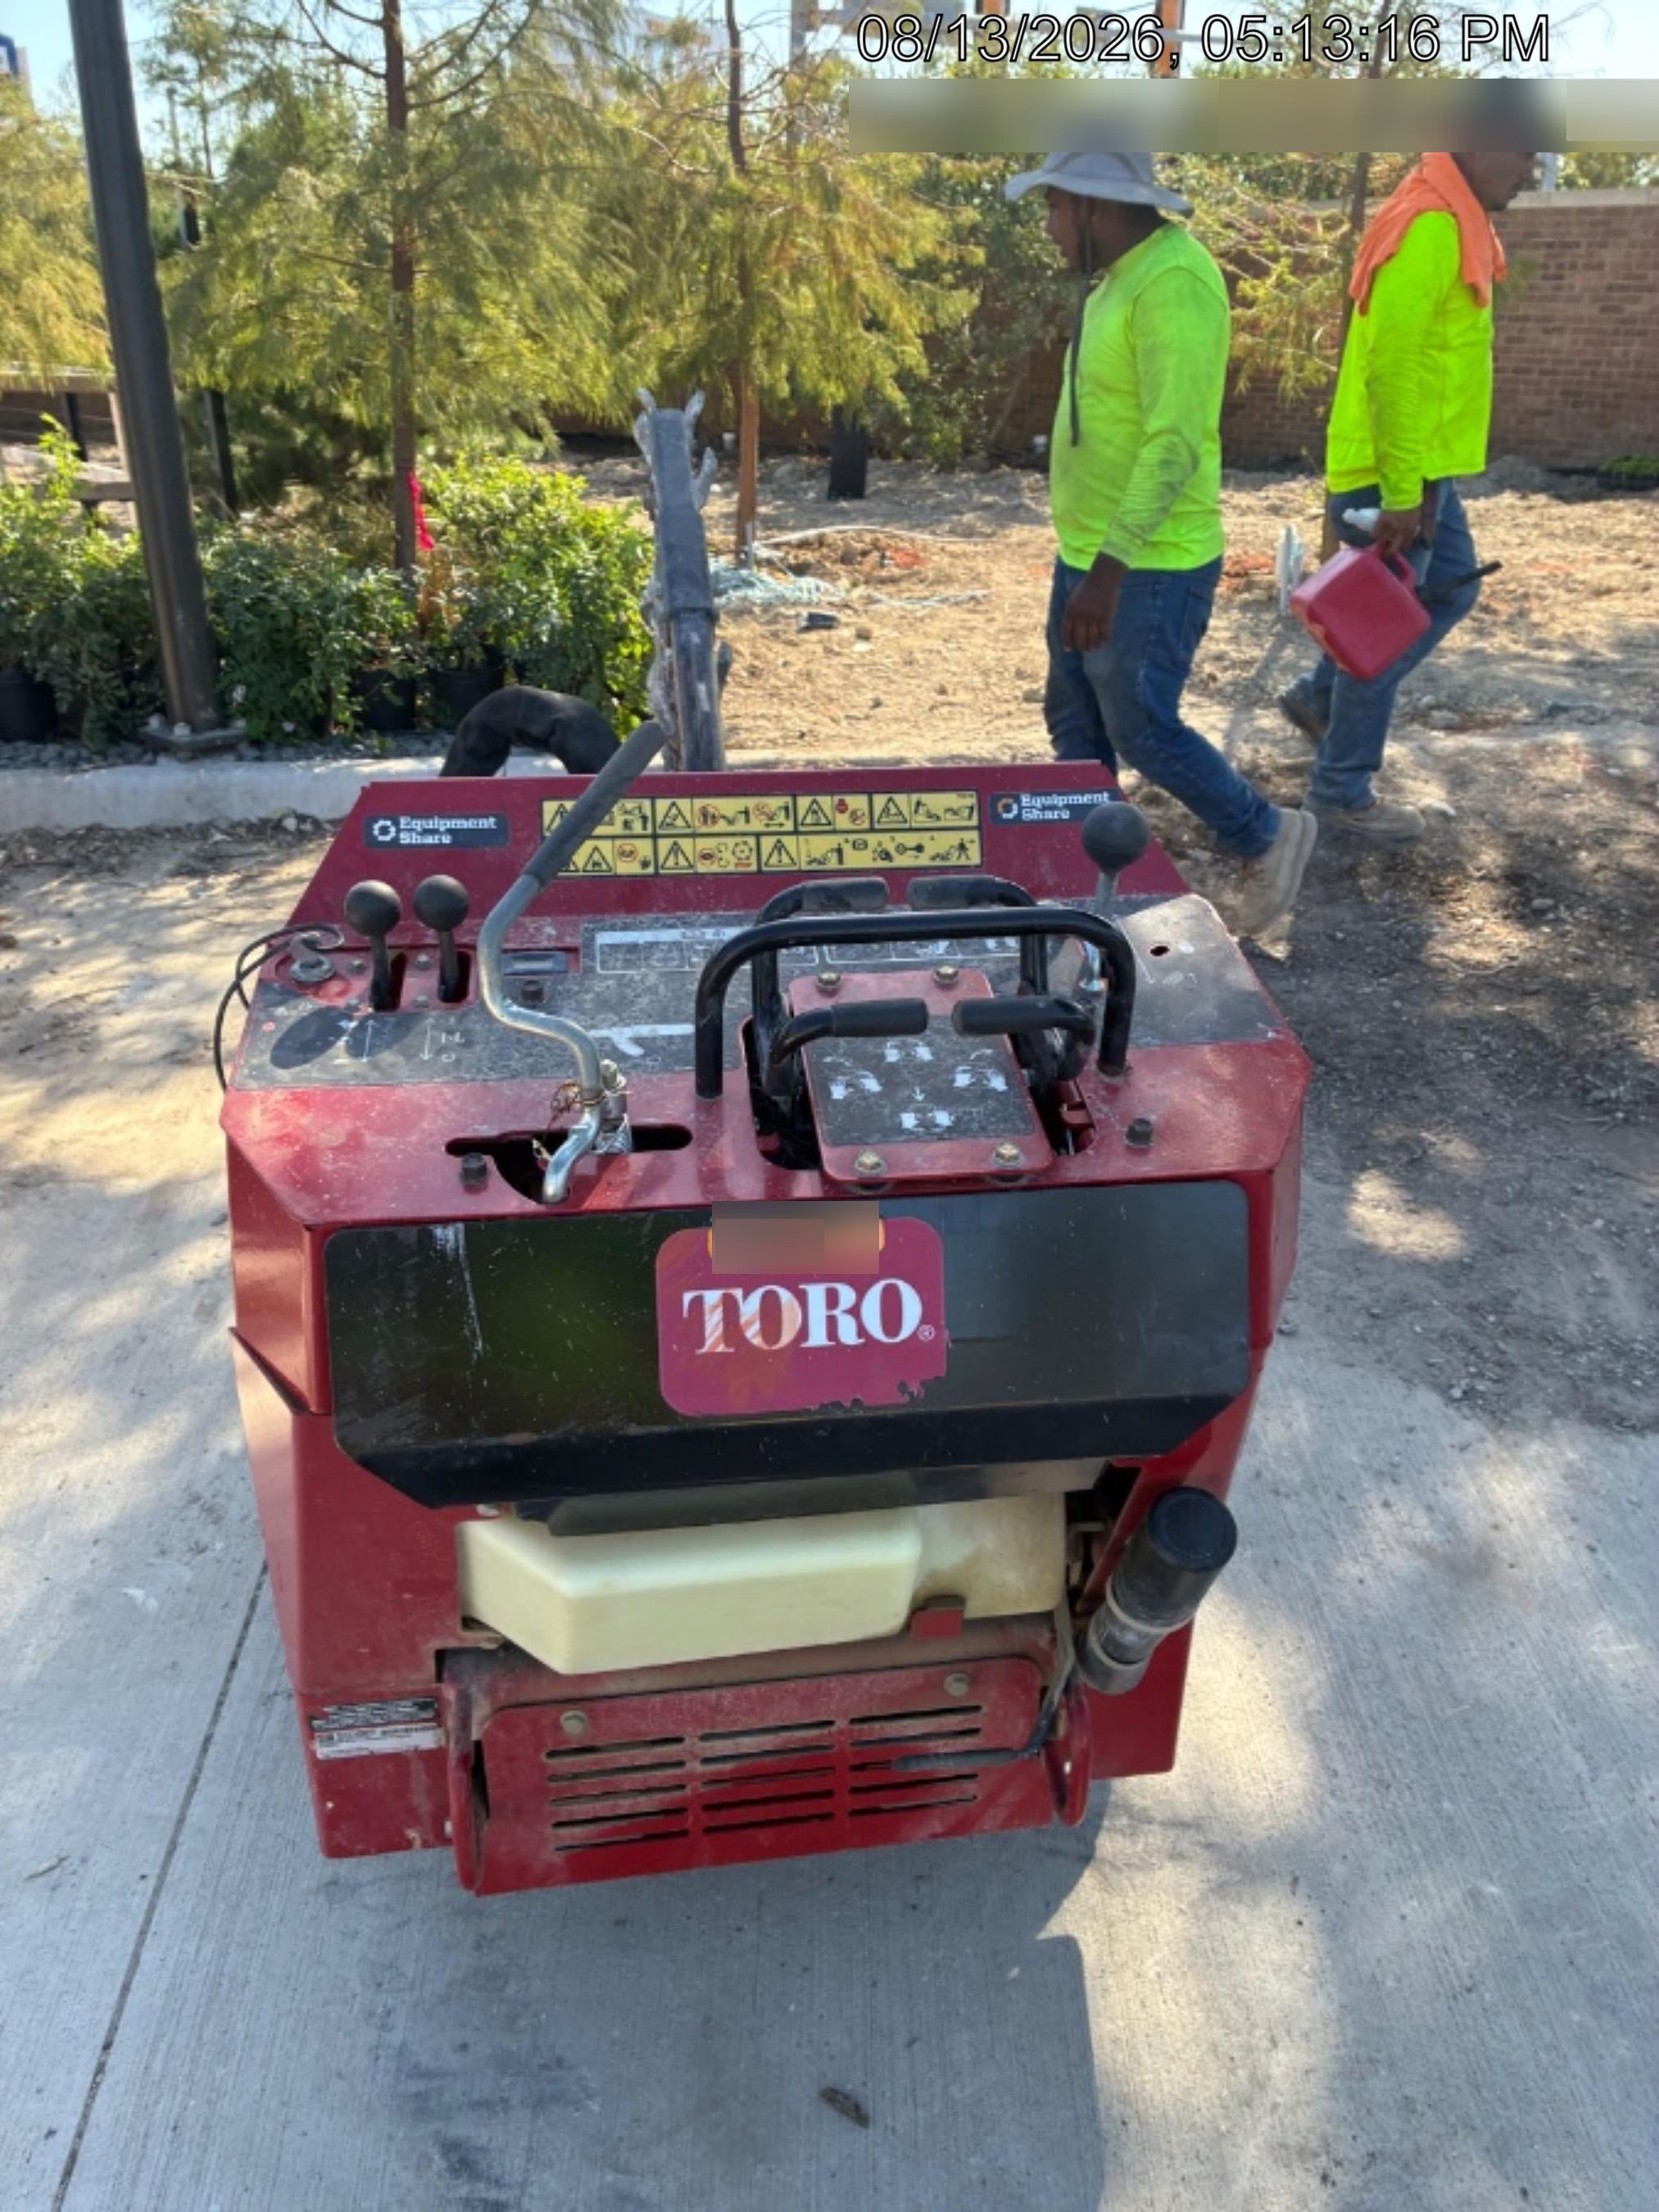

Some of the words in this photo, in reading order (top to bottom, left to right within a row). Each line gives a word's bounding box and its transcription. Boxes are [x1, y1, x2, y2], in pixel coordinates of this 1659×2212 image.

[1021, 791, 1110, 809] Equipment
[1022, 808, 1071, 821] Share
[399, 815, 497, 832] Equipment
[399, 832, 452, 845] Share
[682, 1277, 923, 1356] TORO
